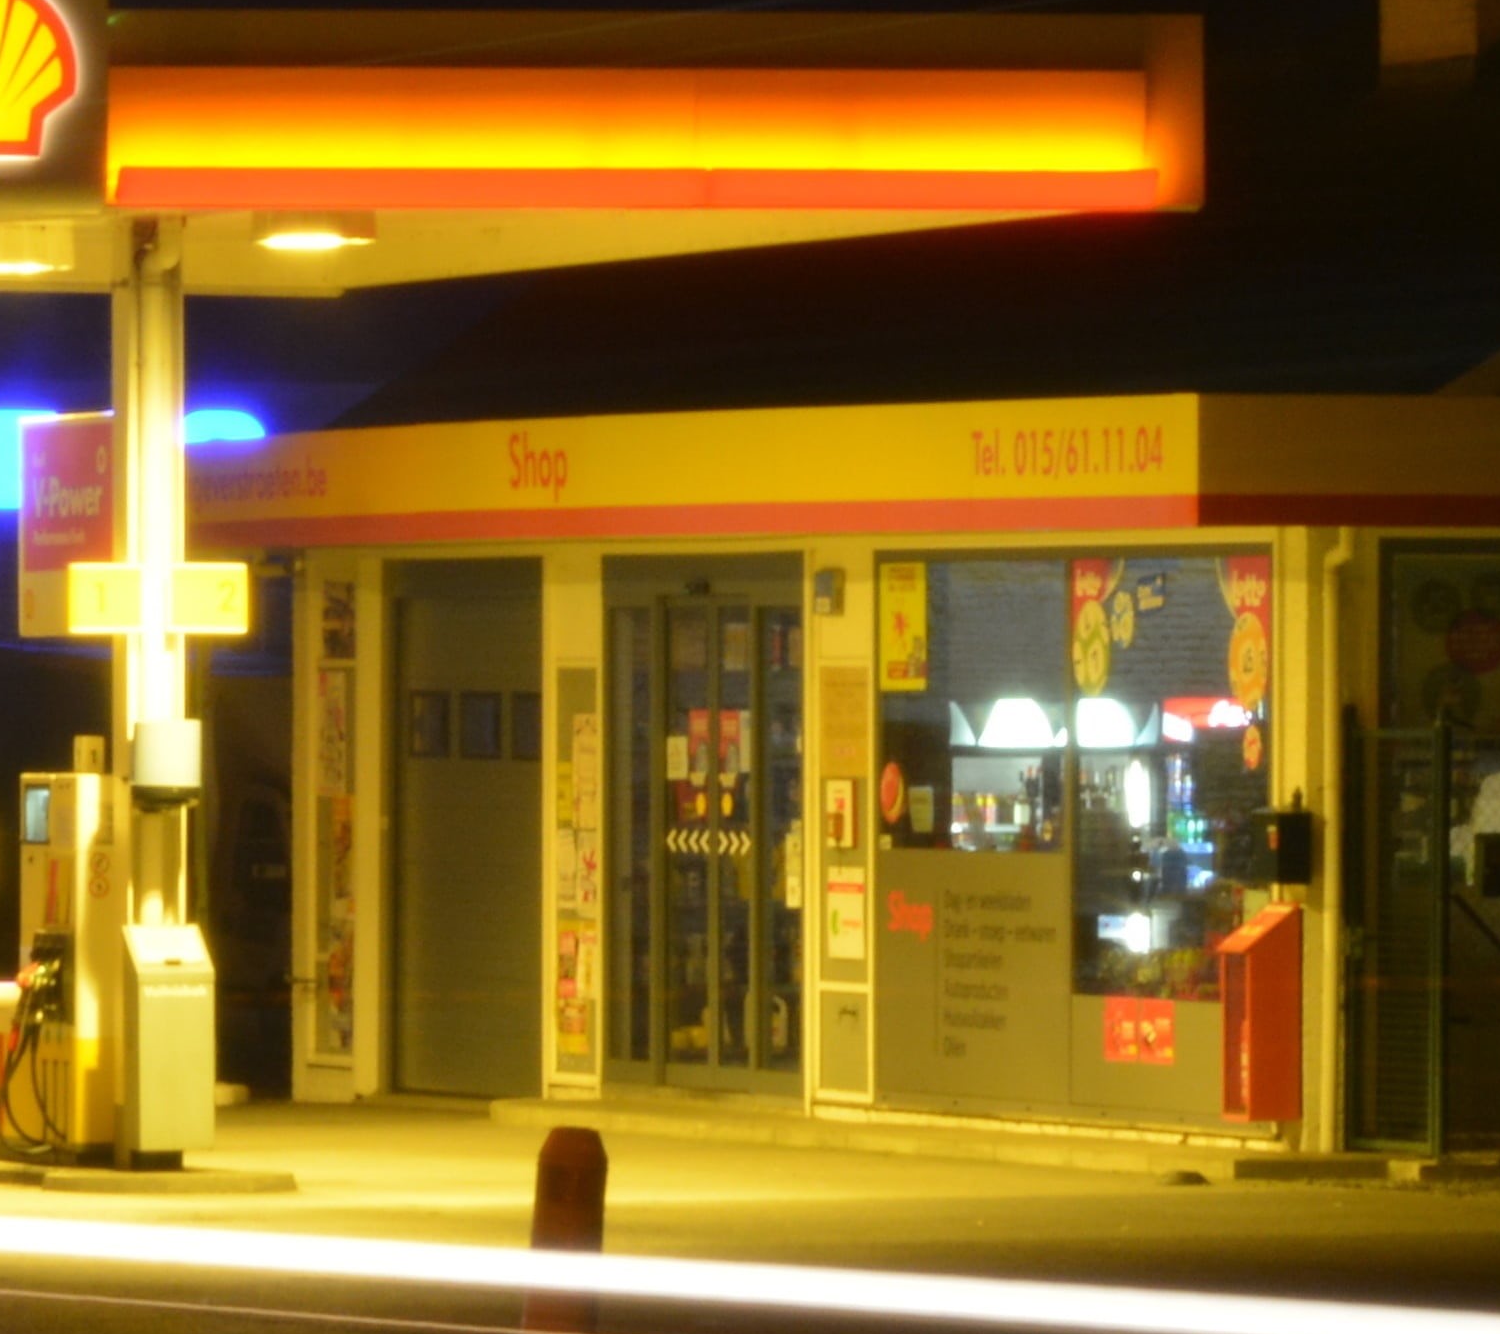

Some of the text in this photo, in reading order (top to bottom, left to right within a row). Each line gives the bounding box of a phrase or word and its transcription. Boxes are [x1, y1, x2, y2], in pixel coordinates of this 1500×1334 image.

[508, 425, 1165, 503] Shop Tel. 015/61.11.04
[33, 476, 104, 519] V-Power
[887, 890, 933, 943] Shop
